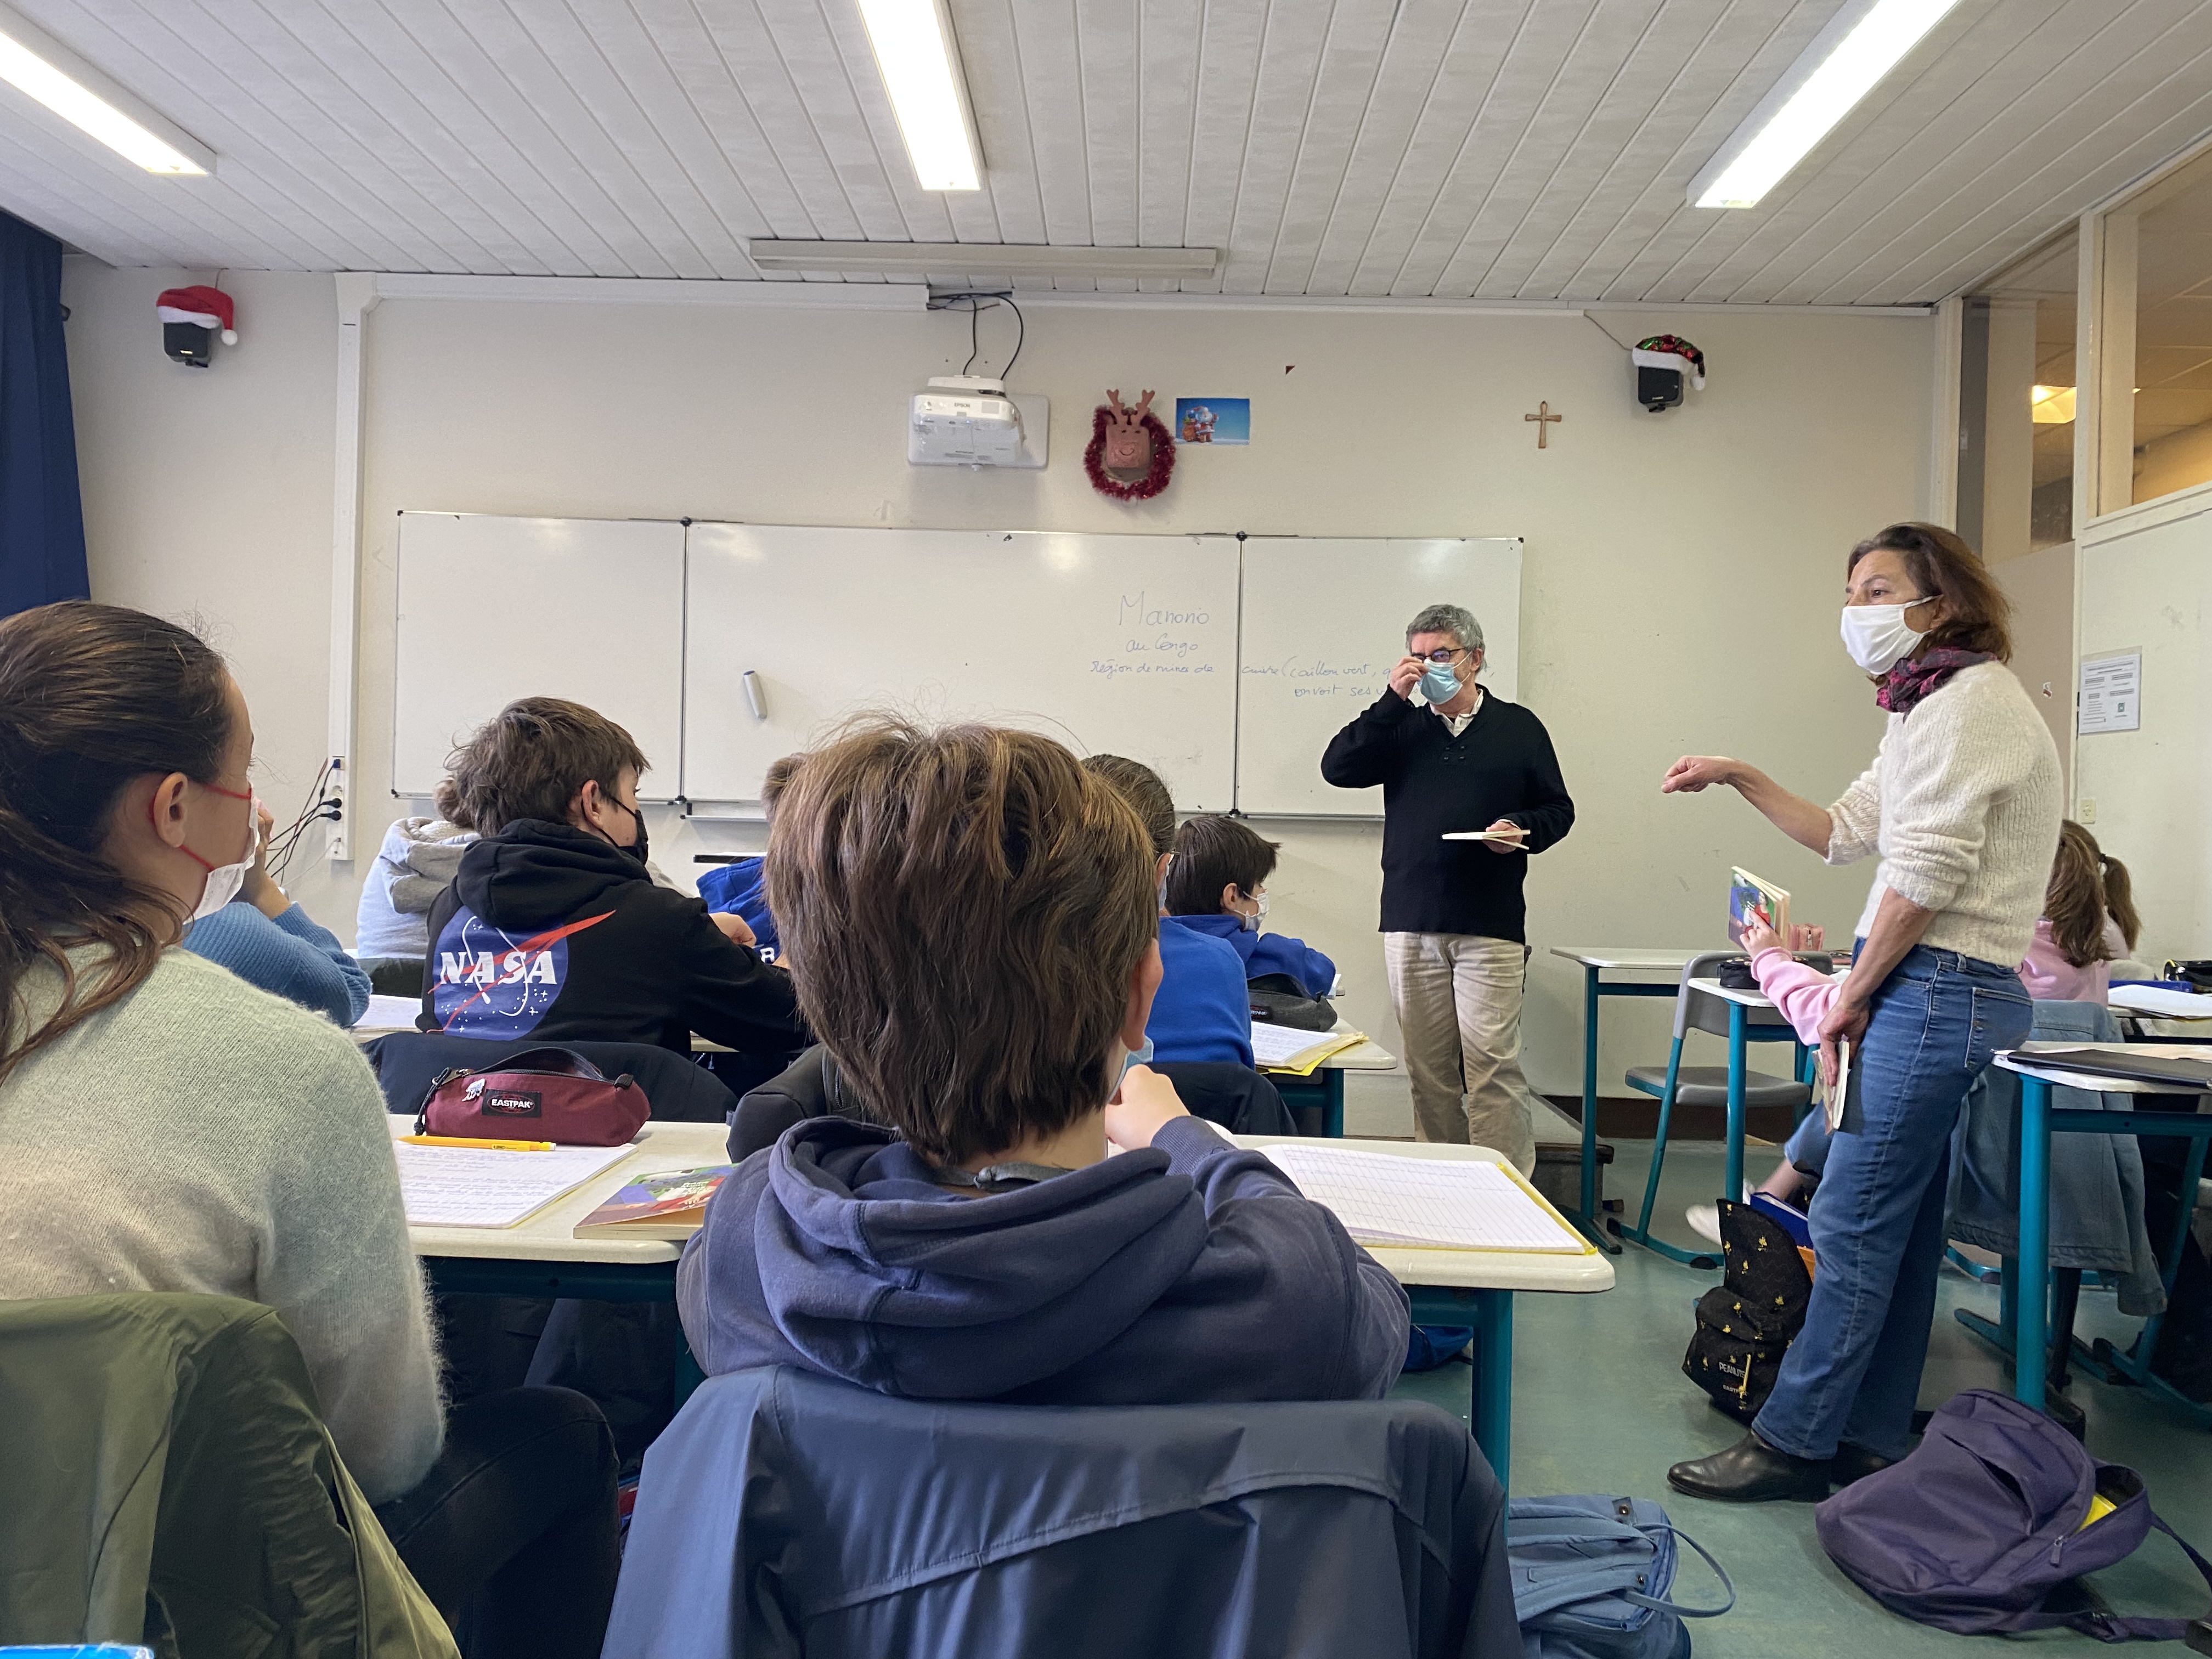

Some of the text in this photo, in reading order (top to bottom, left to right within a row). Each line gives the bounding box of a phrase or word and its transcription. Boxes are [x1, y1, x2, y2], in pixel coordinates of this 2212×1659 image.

[1119, 591, 1209, 625] Manono
[1126, 633, 1198, 658] au Congo
[1136, 663, 1150, 673] de
[1194, 664, 1214, 673] de
[1350, 687, 1370, 696] ses
[440, 951, 557, 985] NASA
